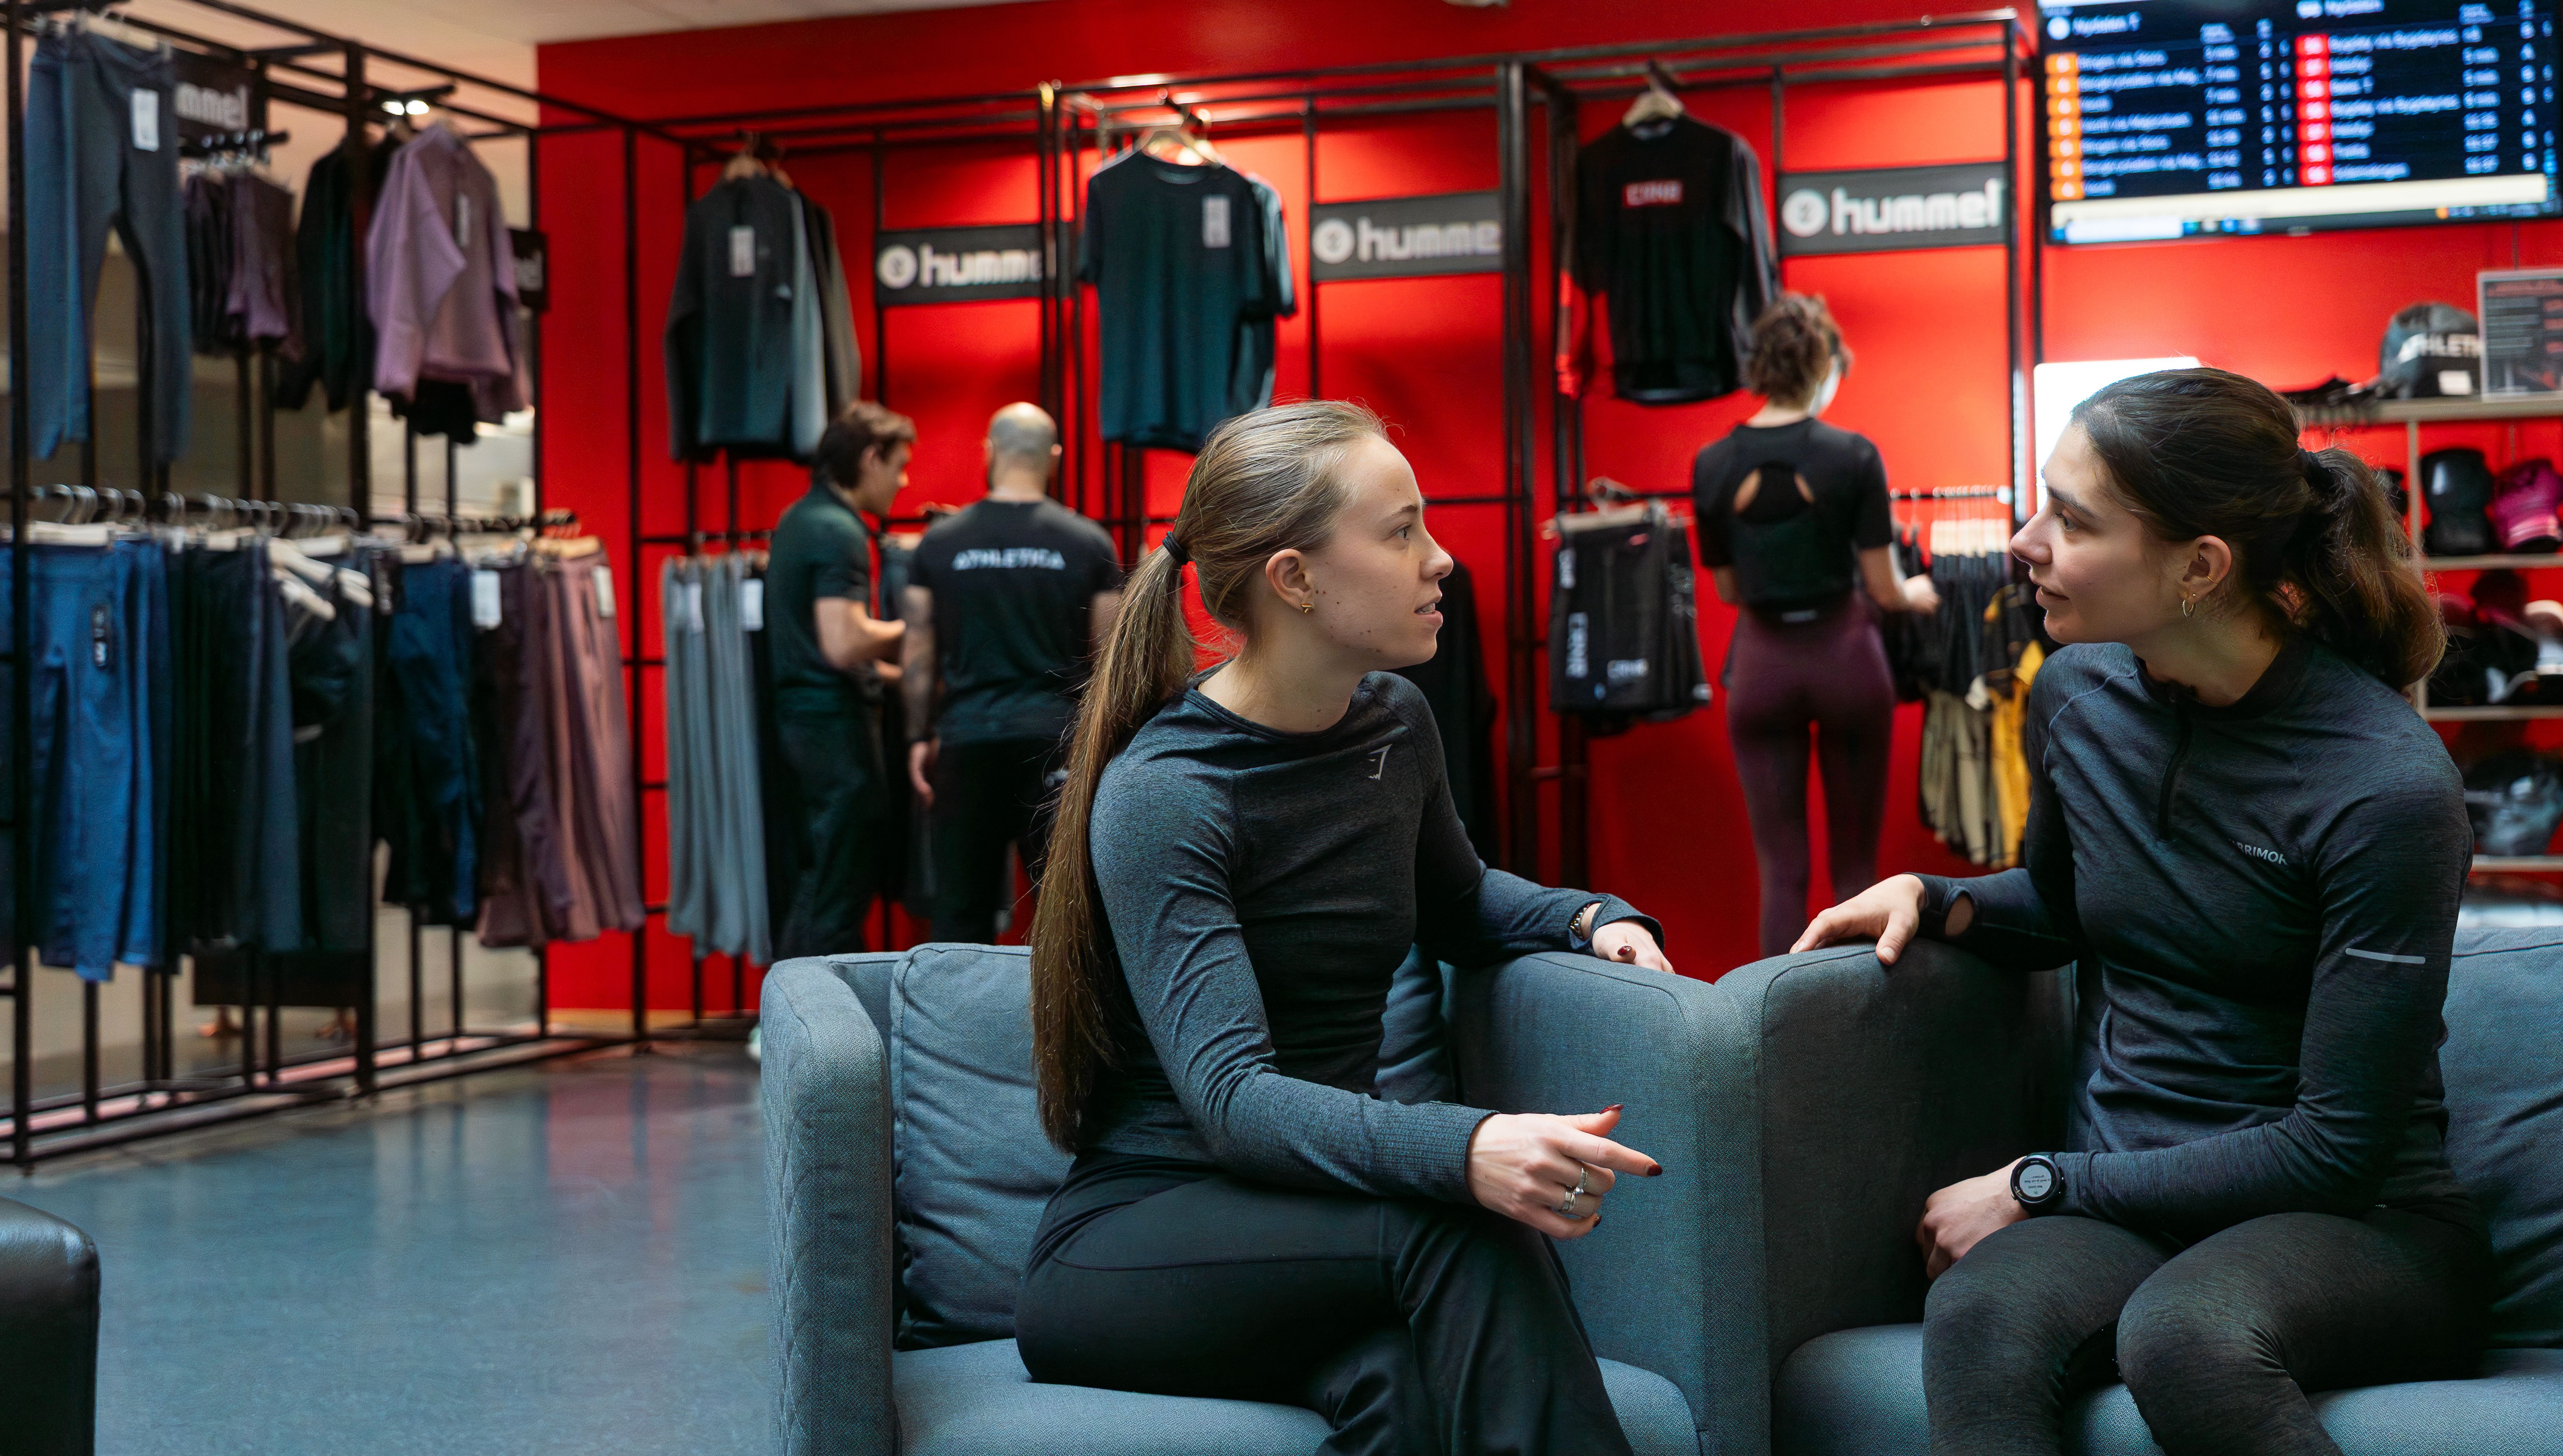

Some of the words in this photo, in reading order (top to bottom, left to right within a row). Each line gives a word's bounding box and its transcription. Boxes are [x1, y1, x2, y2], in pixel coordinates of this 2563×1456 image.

[174, 82, 248, 131] mmel
[1831, 178, 2001, 236] hummel
[1358, 216, 1501, 262] humme
[918, 242, 1043, 288] humme
